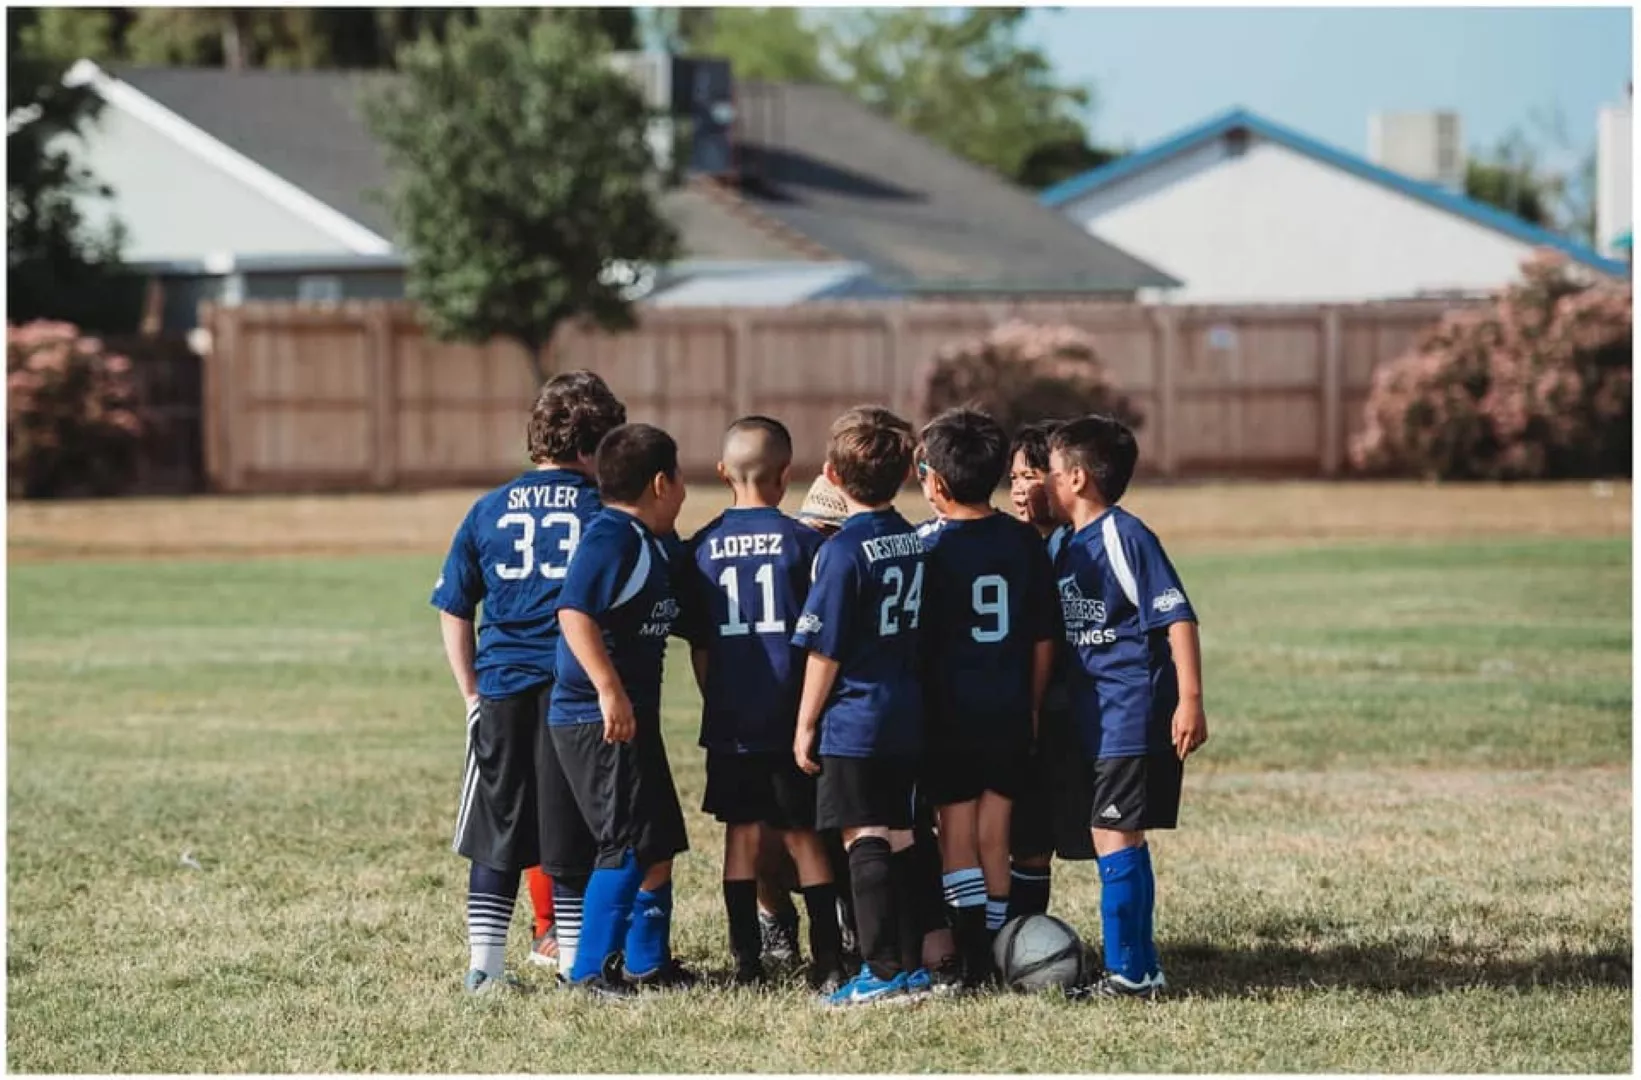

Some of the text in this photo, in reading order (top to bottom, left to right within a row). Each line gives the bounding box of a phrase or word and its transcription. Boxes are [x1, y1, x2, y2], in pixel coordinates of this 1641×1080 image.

[508, 486, 578, 509] SKYLER
[495, 512, 580, 579] 33
[710, 533, 783, 560] LOPEZ
[719, 563, 785, 636] 11
[880, 561, 924, 636] 24
[972, 575, 1008, 642] 9
